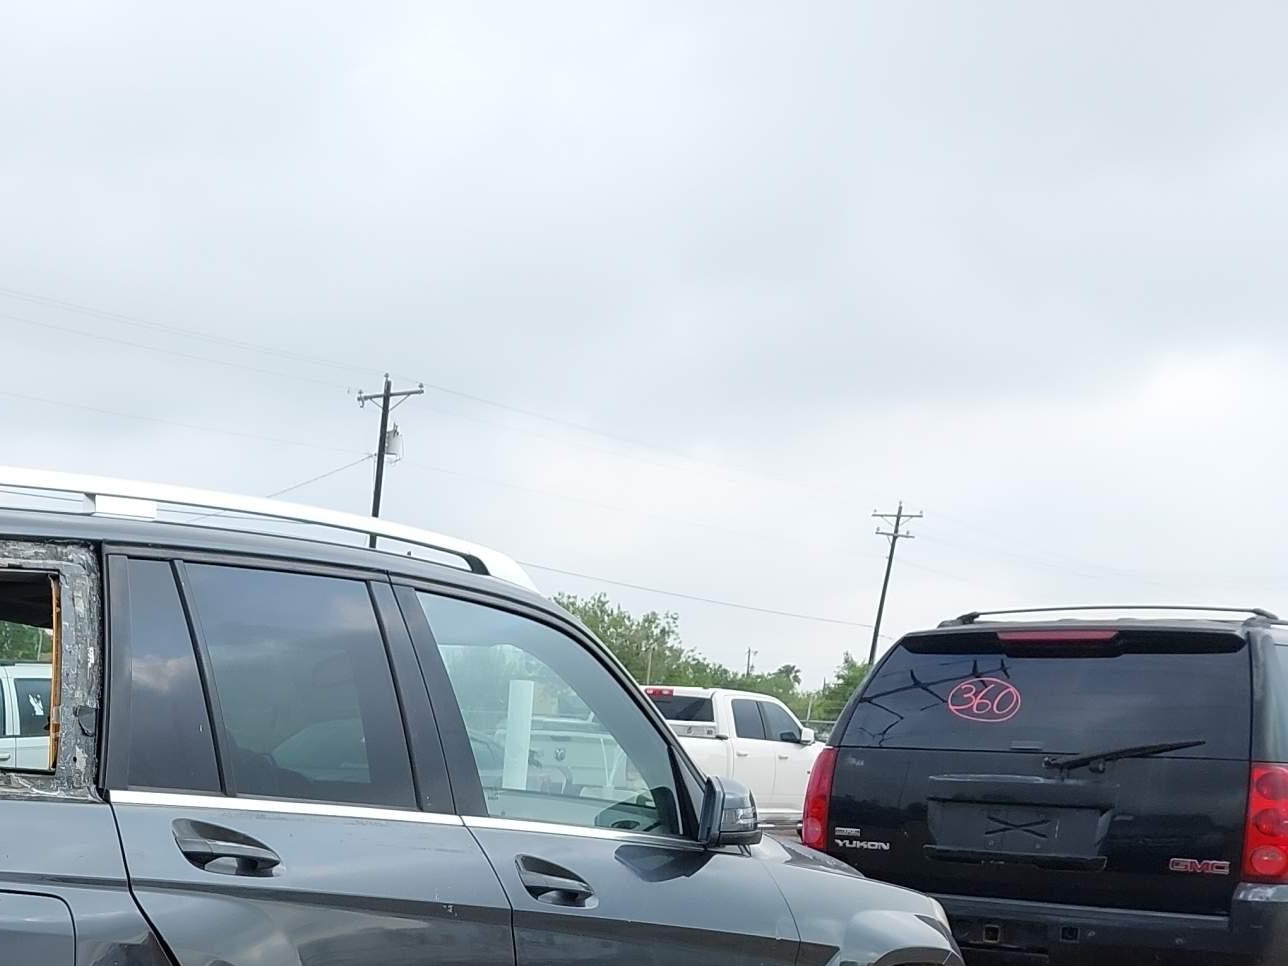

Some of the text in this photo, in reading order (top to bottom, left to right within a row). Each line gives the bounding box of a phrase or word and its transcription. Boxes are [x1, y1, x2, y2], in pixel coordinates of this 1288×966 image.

[951, 683, 1017, 714] 360
[834, 838, 890, 850] YUKON
[1169, 857, 1230, 875] GMC
